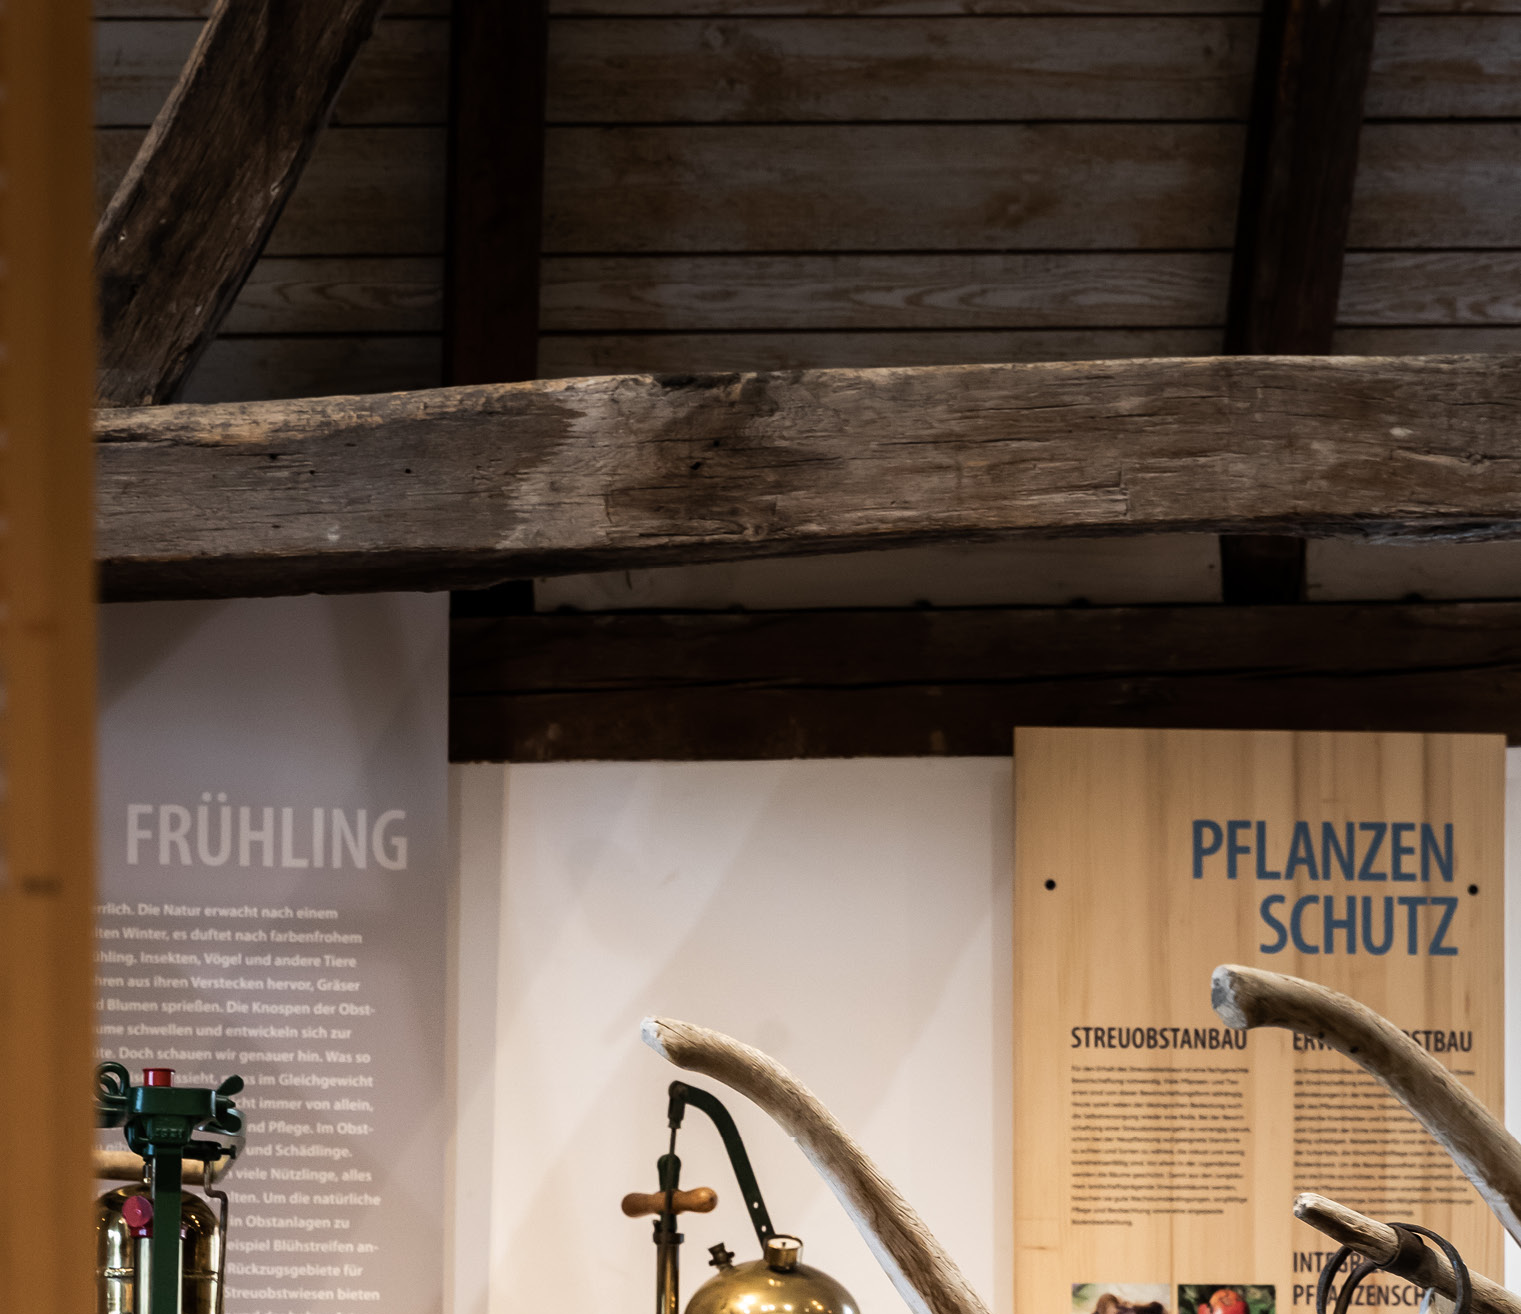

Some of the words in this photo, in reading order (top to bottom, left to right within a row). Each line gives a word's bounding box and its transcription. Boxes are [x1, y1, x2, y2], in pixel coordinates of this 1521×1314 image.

[126, 792, 408, 871] FRÜHLING
[1192, 819, 1454, 882] PFLANZEN
[138, 903, 161, 915] Die
[164, 904, 201, 916] Natur
[204, 906, 258, 918] erwacht
[261, 906, 293, 918] nach
[296, 908, 338, 919] einem
[1259, 894, 1459, 956] SCHUTZ
[122, 927, 169, 941] Winter,
[172, 930, 187, 940] es
[190, 928, 232, 940] duftet
[235, 930, 267, 941] nach
[270, 929, 363, 943] farbenfrohem
[141, 951, 201, 965] Insekten,
[204, 952, 242, 968] Vögel
[245, 954, 271, 966] und
[274, 954, 321, 967] andere
[323, 955, 357, 968] Tiere
[127, 977, 150, 987] aus
[154, 976, 188, 988] ihren
[191, 976, 264, 989] Verstecken
[266, 977, 314, 992] hervor,
[317, 978, 361, 991] Gräser
[107, 999, 158, 1011] Blumen
[162, 1000, 224, 1014] sprießen.
[226, 1001, 249, 1013] Die
[252, 1002, 310, 1016] Knospen
[313, 1002, 336, 1015] der
[338, 1003, 375, 1016] Obst-
[127, 1023, 193, 1036] schwellen
[195, 1024, 222, 1036] und
[226, 1025, 298, 1038] entwickeln
[301, 1026, 327, 1039] sich
[330, 1029, 352, 1039] zur
[1070, 1027, 1248, 1050] STREUOBSTANBAU
[119, 1047, 153, 1059] Doch
[157, 1047, 212, 1060] schauen
[215, 1049, 236, 1061] wir
[239, 1051, 295, 1064] genauer
[297, 1050, 323, 1062] hin.
[325, 1051, 352, 1063] Was
[355, 1053, 371, 1063] so
[258, 1073, 275, 1086] im
[278, 1074, 373, 1089] Gleichgewicht
[259, 1098, 302, 1109] immer
[305, 1101, 330, 1110] von
[333, 1100, 374, 1112] allein,
[269, 1121, 313, 1136] Pflege.
[316, 1123, 333, 1134] Im
[336, 1122, 374, 1135] Obst-
[245, 1145, 272, 1156] und
[275, 1144, 352, 1160] Schädlinge.
[235, 1168, 267, 1180] viele
[270, 1168, 338, 1183] Nützlinge,
[341, 1169, 372, 1182] alles
[263, 1193, 286, 1204] Um
[289, 1192, 312, 1204] die
[313, 1193, 381, 1206] natürliche
[229, 1215, 242, 1227] in
[245, 1215, 331, 1230] Obstanlagen
[334, 1218, 350, 1229] zu
[273, 1239, 354, 1253] Blühstreifen
[357, 1243, 379, 1253] an-
[227, 1262, 341, 1278] Rückzugsgebiete
[343, 1264, 363, 1276] für
[224, 1287, 334, 1300] Streuobstwiesen
[337, 1288, 380, 1300] bieten
